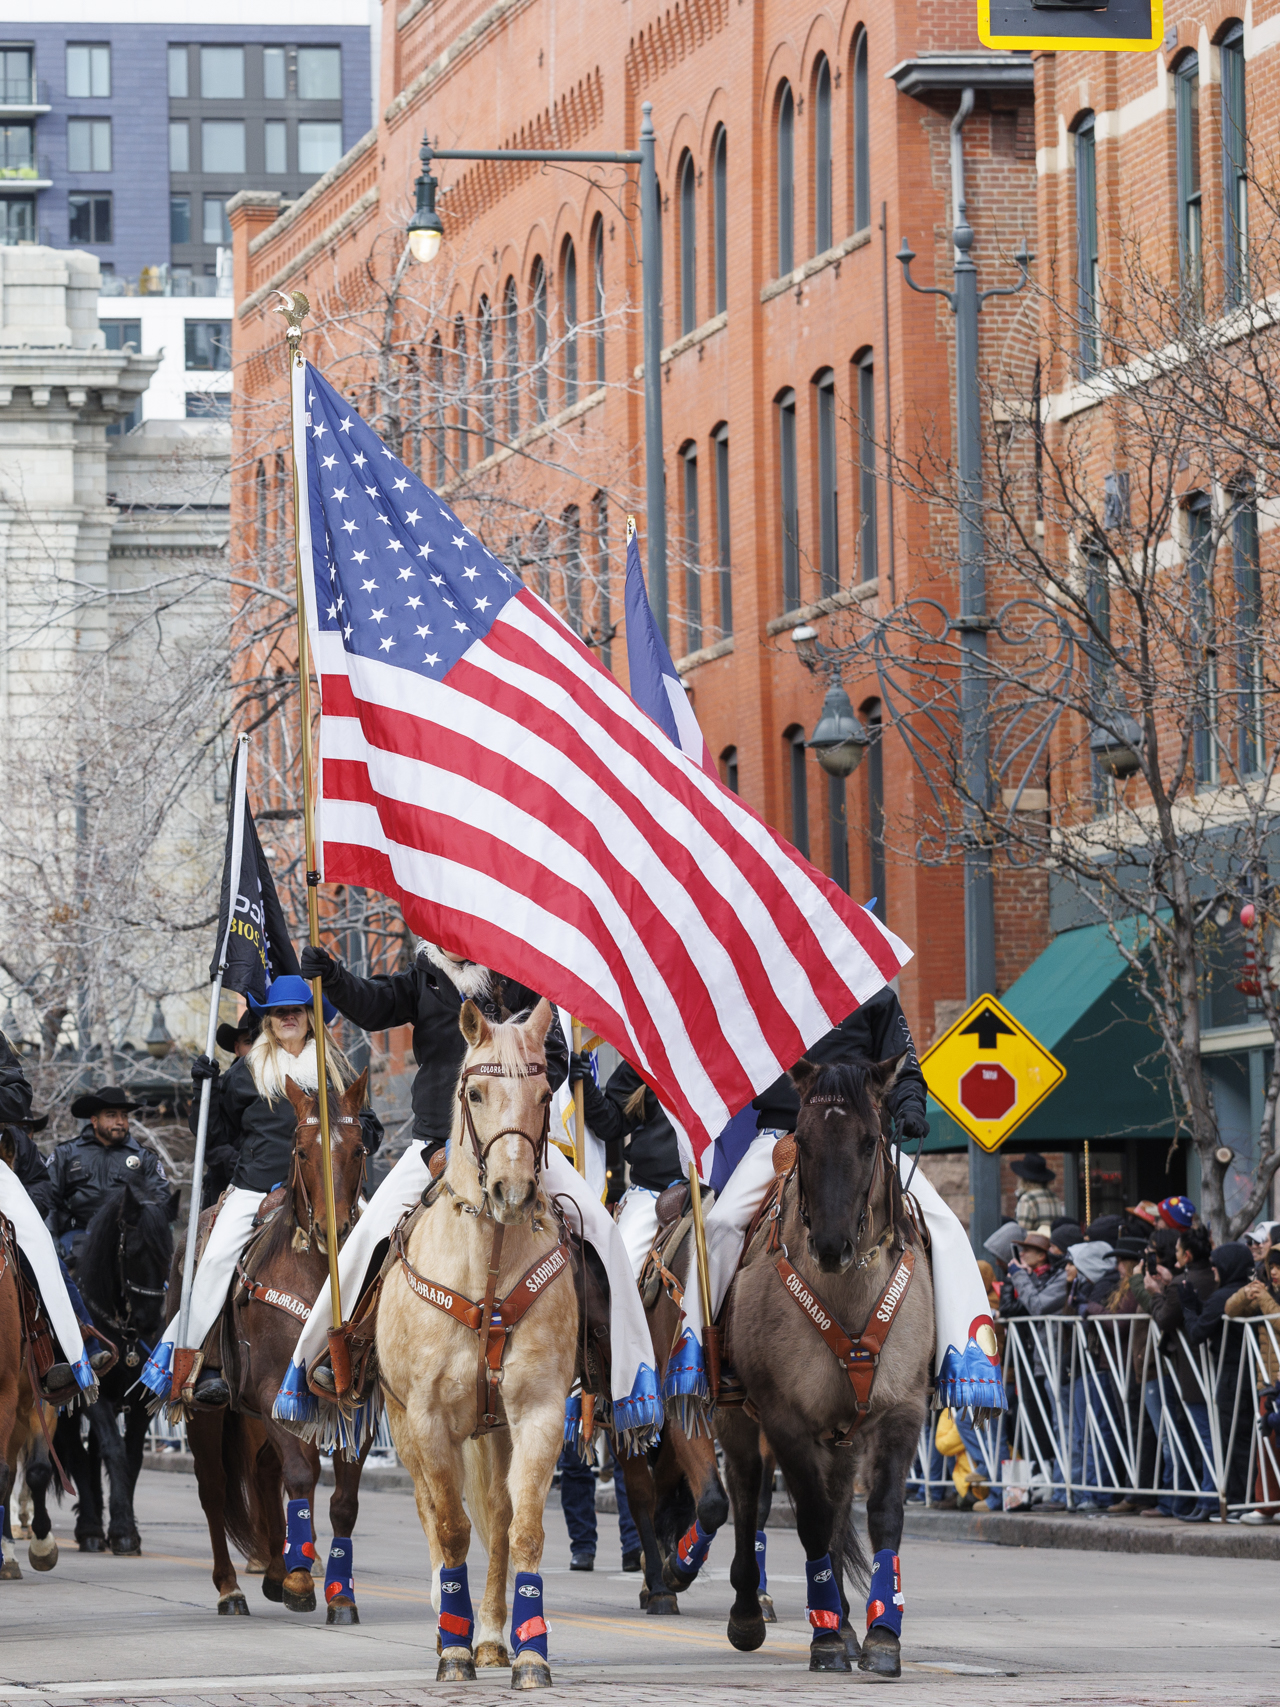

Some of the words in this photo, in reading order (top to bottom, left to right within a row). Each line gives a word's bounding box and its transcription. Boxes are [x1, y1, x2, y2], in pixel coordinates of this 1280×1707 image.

[264, 1288, 312, 1320] COLORADO
[407, 1271, 453, 1310] COLORADO
[525, 1248, 566, 1294] SADDLERY
[786, 1272, 832, 1332] COLORADO
[876, 1262, 912, 1324] SADDLERY
